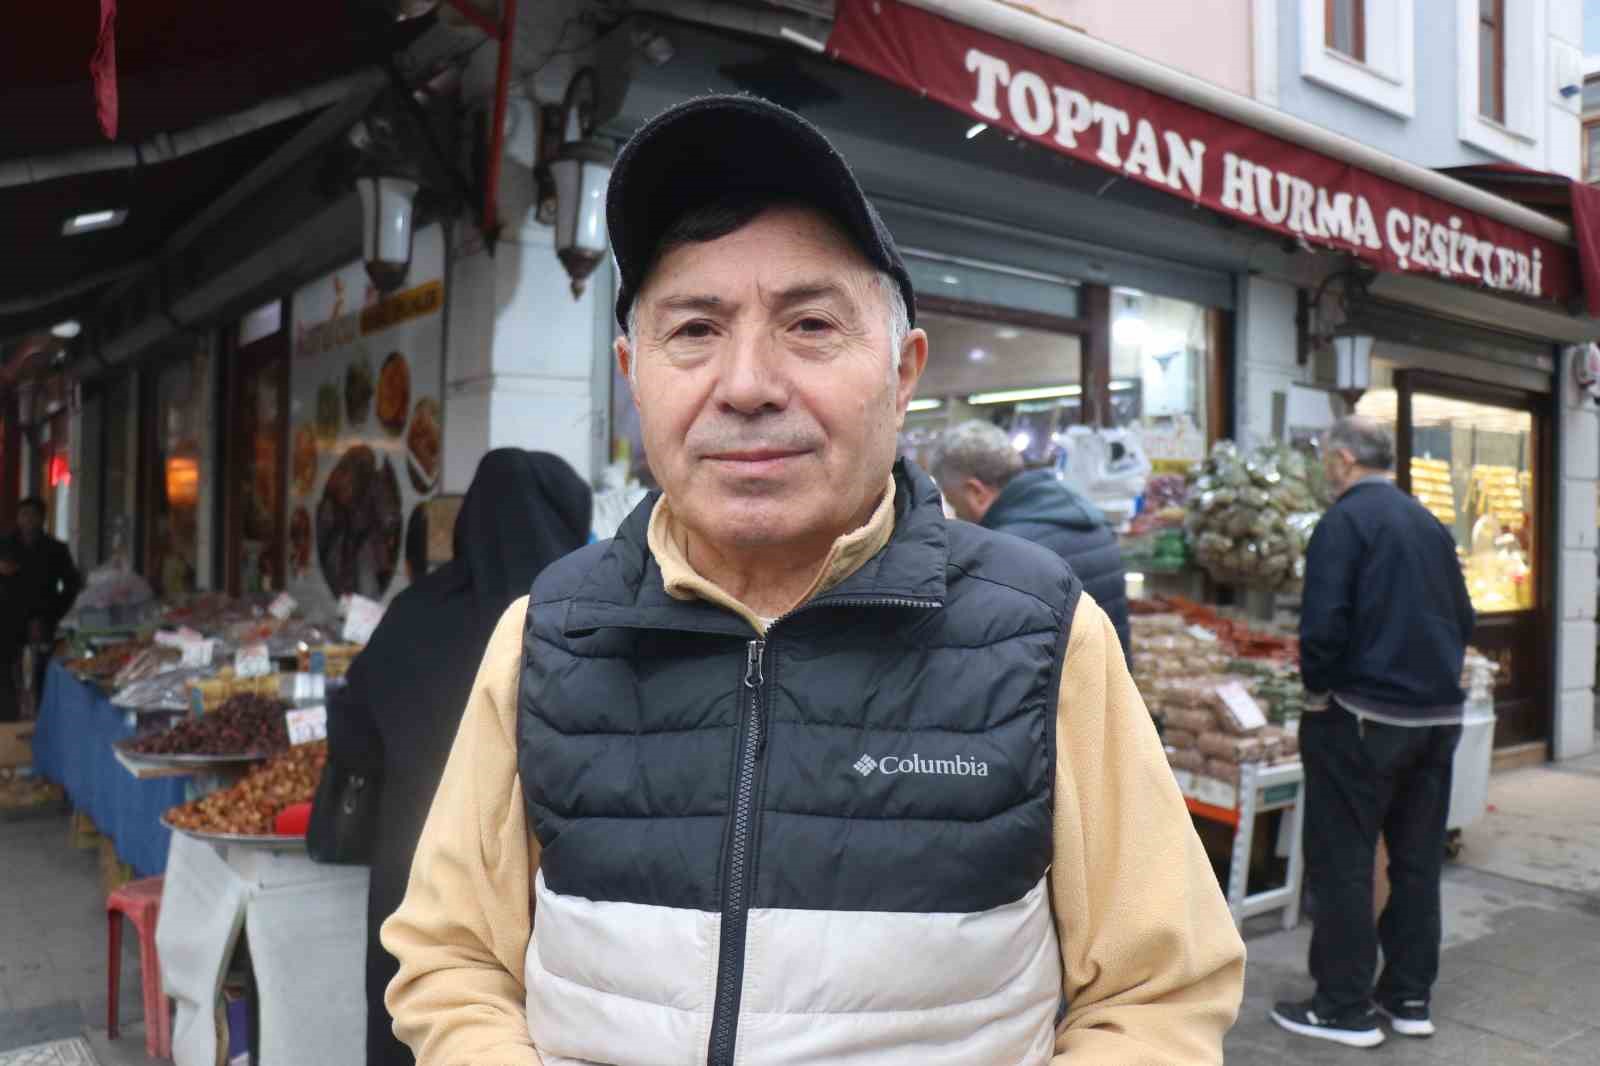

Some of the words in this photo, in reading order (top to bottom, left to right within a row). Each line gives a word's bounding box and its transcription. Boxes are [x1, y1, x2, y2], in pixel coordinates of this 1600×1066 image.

[965, 49, 1206, 197] TOPTAN
[1221, 152, 1382, 249] HURMA
[879, 753, 989, 776] Columbia
